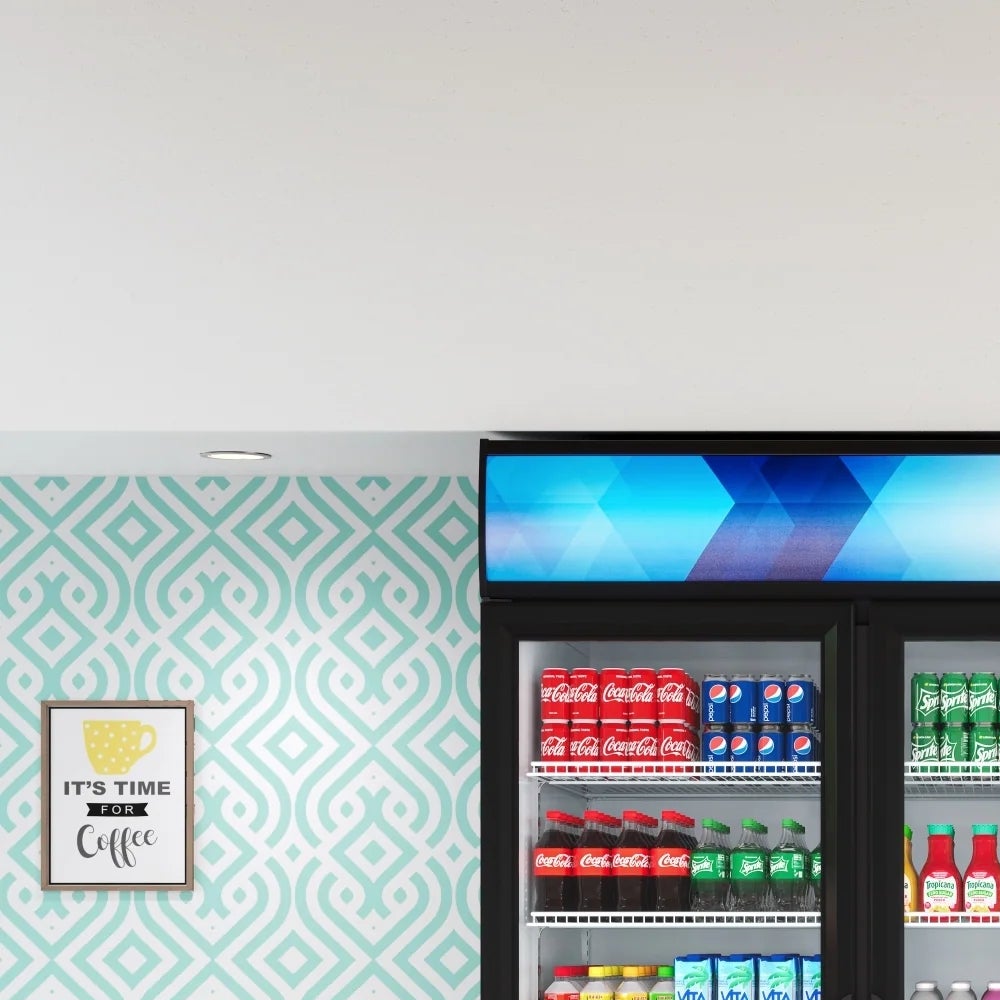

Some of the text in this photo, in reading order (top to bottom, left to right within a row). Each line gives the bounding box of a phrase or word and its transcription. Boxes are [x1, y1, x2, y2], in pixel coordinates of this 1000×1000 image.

[64, 781, 171, 796] IT'S TIME
[101, 805, 134, 815] FOR
[76, 824, 158, 869] Coffee
[926, 880, 955, 890] Tropicana
[967, 880, 994, 890] Tropicana
